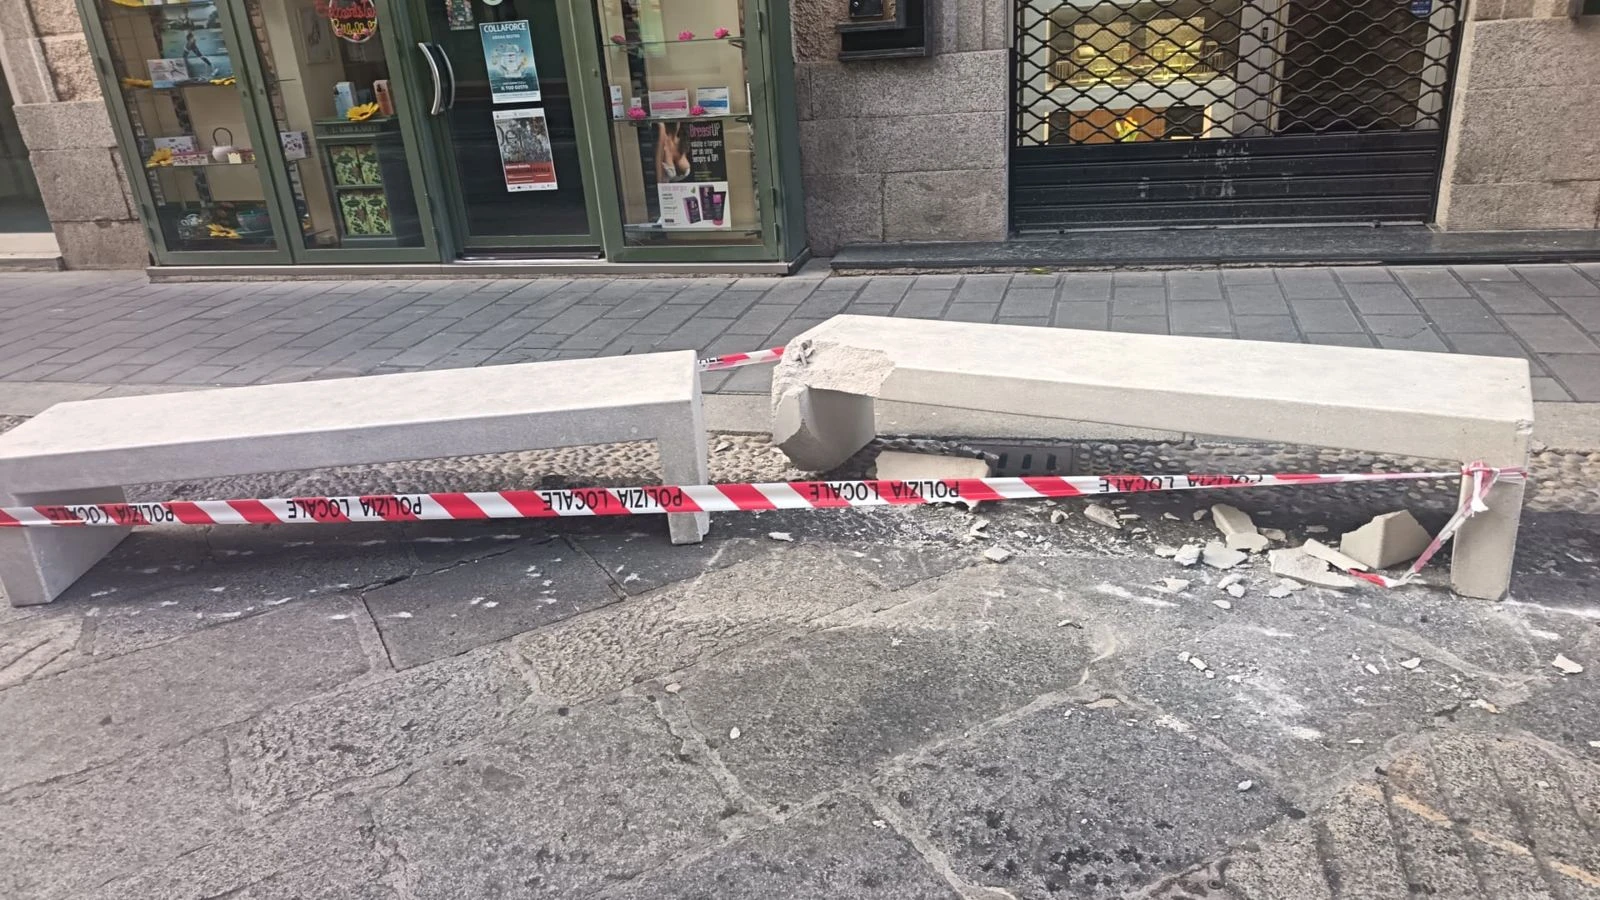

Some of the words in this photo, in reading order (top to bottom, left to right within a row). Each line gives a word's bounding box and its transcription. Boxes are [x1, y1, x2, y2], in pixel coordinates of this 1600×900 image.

[483, 22, 527, 33] COLLAFORCE
[809, 482, 879, 500] LOCALE
[891, 480, 959, 499] POLIZIA
[1099, 476, 1174, 492] LOCALE
[359, 496, 422, 516] POLIZIA
[541, 490, 608, 511] LOCALE
[616, 487, 683, 508] POLIZIA
[117, 504, 175, 522] POLIZIA
[286, 498, 350, 518] LOCALE
